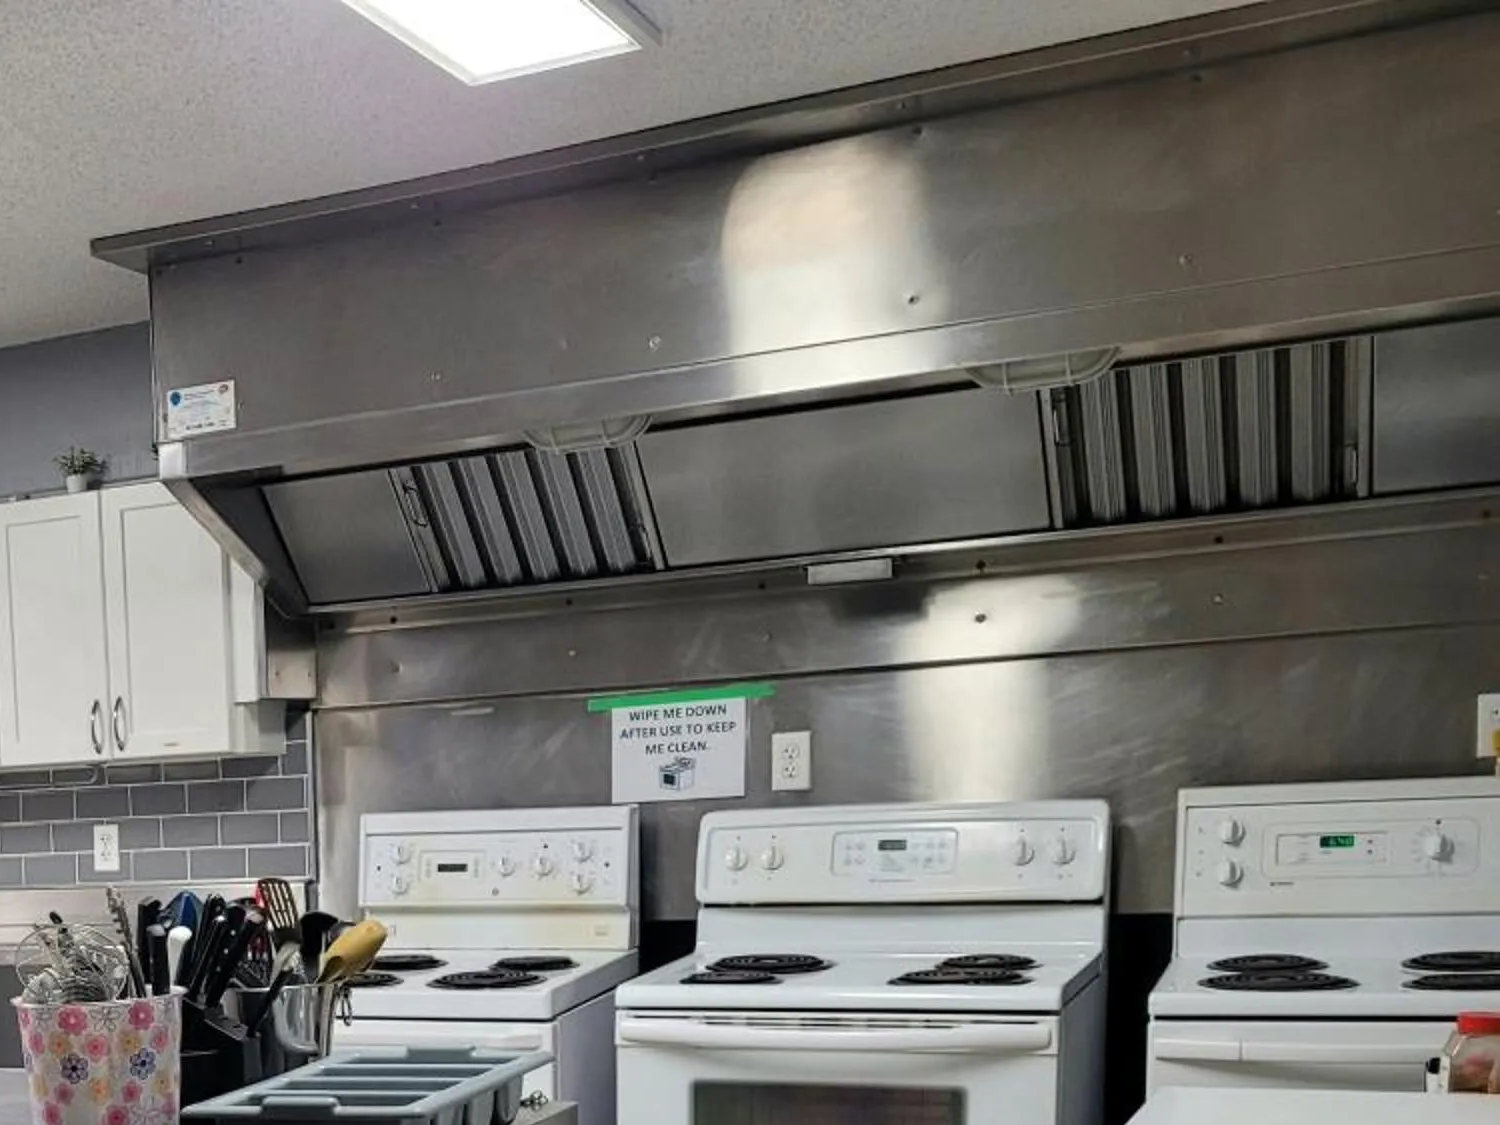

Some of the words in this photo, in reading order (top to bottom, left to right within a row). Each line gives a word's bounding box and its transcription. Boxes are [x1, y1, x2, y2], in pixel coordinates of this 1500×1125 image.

[629, 708, 660, 722] WIPE
[663, 706, 683, 720] ME
[685, 703, 727, 717] DOWN
[619, 727, 657, 740] AFTER
[659, 725, 682, 738] USE
[686, 723, 704, 735] TO
[706, 721, 738, 734] KEEP
[645, 743, 665, 756] ME
